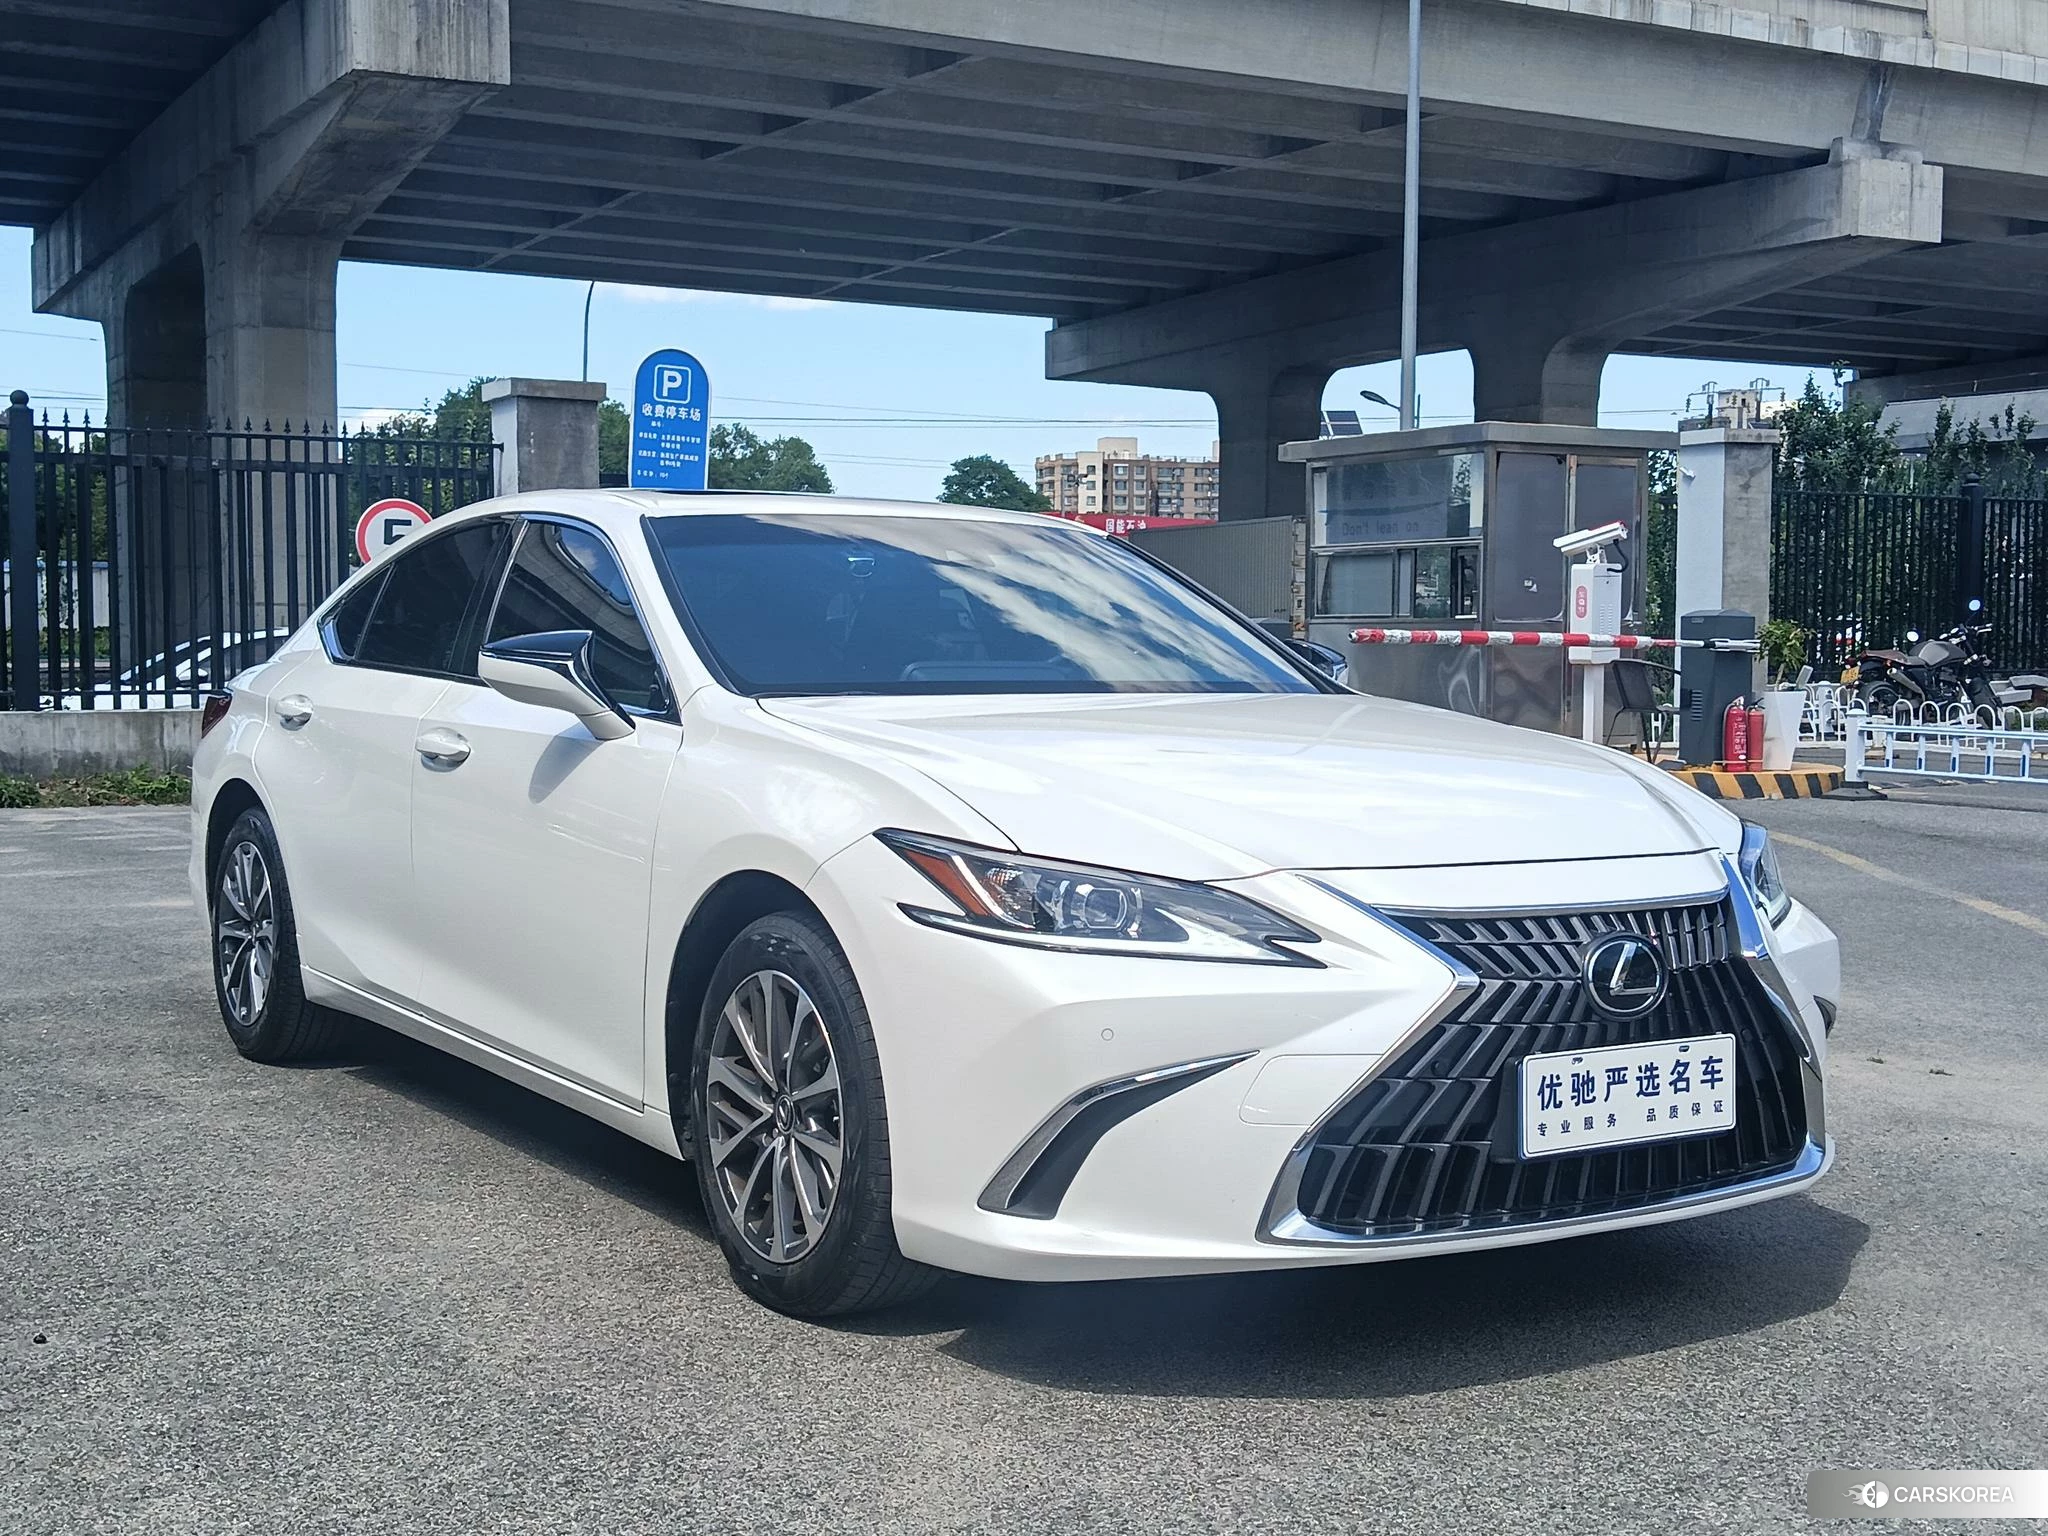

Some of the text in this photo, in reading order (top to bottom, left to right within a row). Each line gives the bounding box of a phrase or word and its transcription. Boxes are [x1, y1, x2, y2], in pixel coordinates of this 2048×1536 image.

[662, 370, 682, 397] P
[642, 402, 701, 422] 收费停车场
[1537, 1055, 1724, 1111] 优驰严选名车
[1537, 1100, 1724, 1137] 专业服务 品质保证
